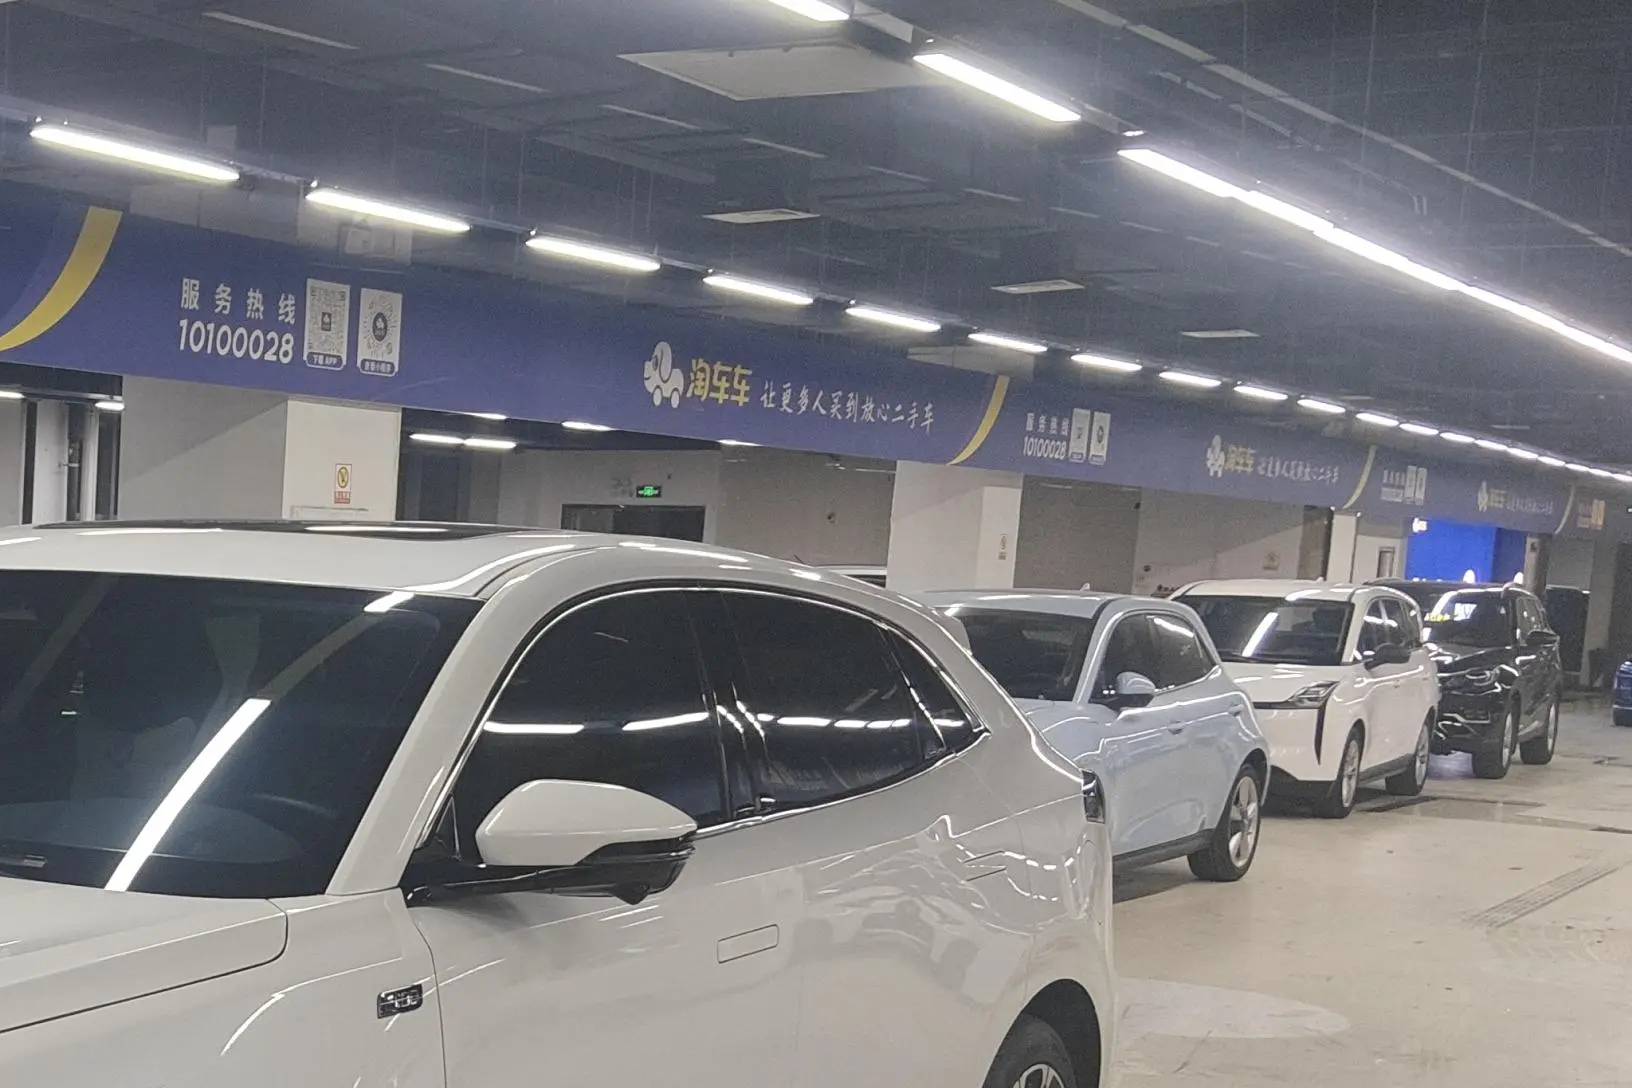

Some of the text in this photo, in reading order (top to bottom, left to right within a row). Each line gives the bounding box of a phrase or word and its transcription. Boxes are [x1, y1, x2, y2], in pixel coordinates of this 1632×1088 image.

[180, 278, 296, 325] 服务热线
[179, 319, 294, 363] 10100028
[686, 358, 753, 407] 淘车车
[760, 380, 934, 434] 让更多人买到放心二手车
[1023, 436, 1067, 460] 10100028
